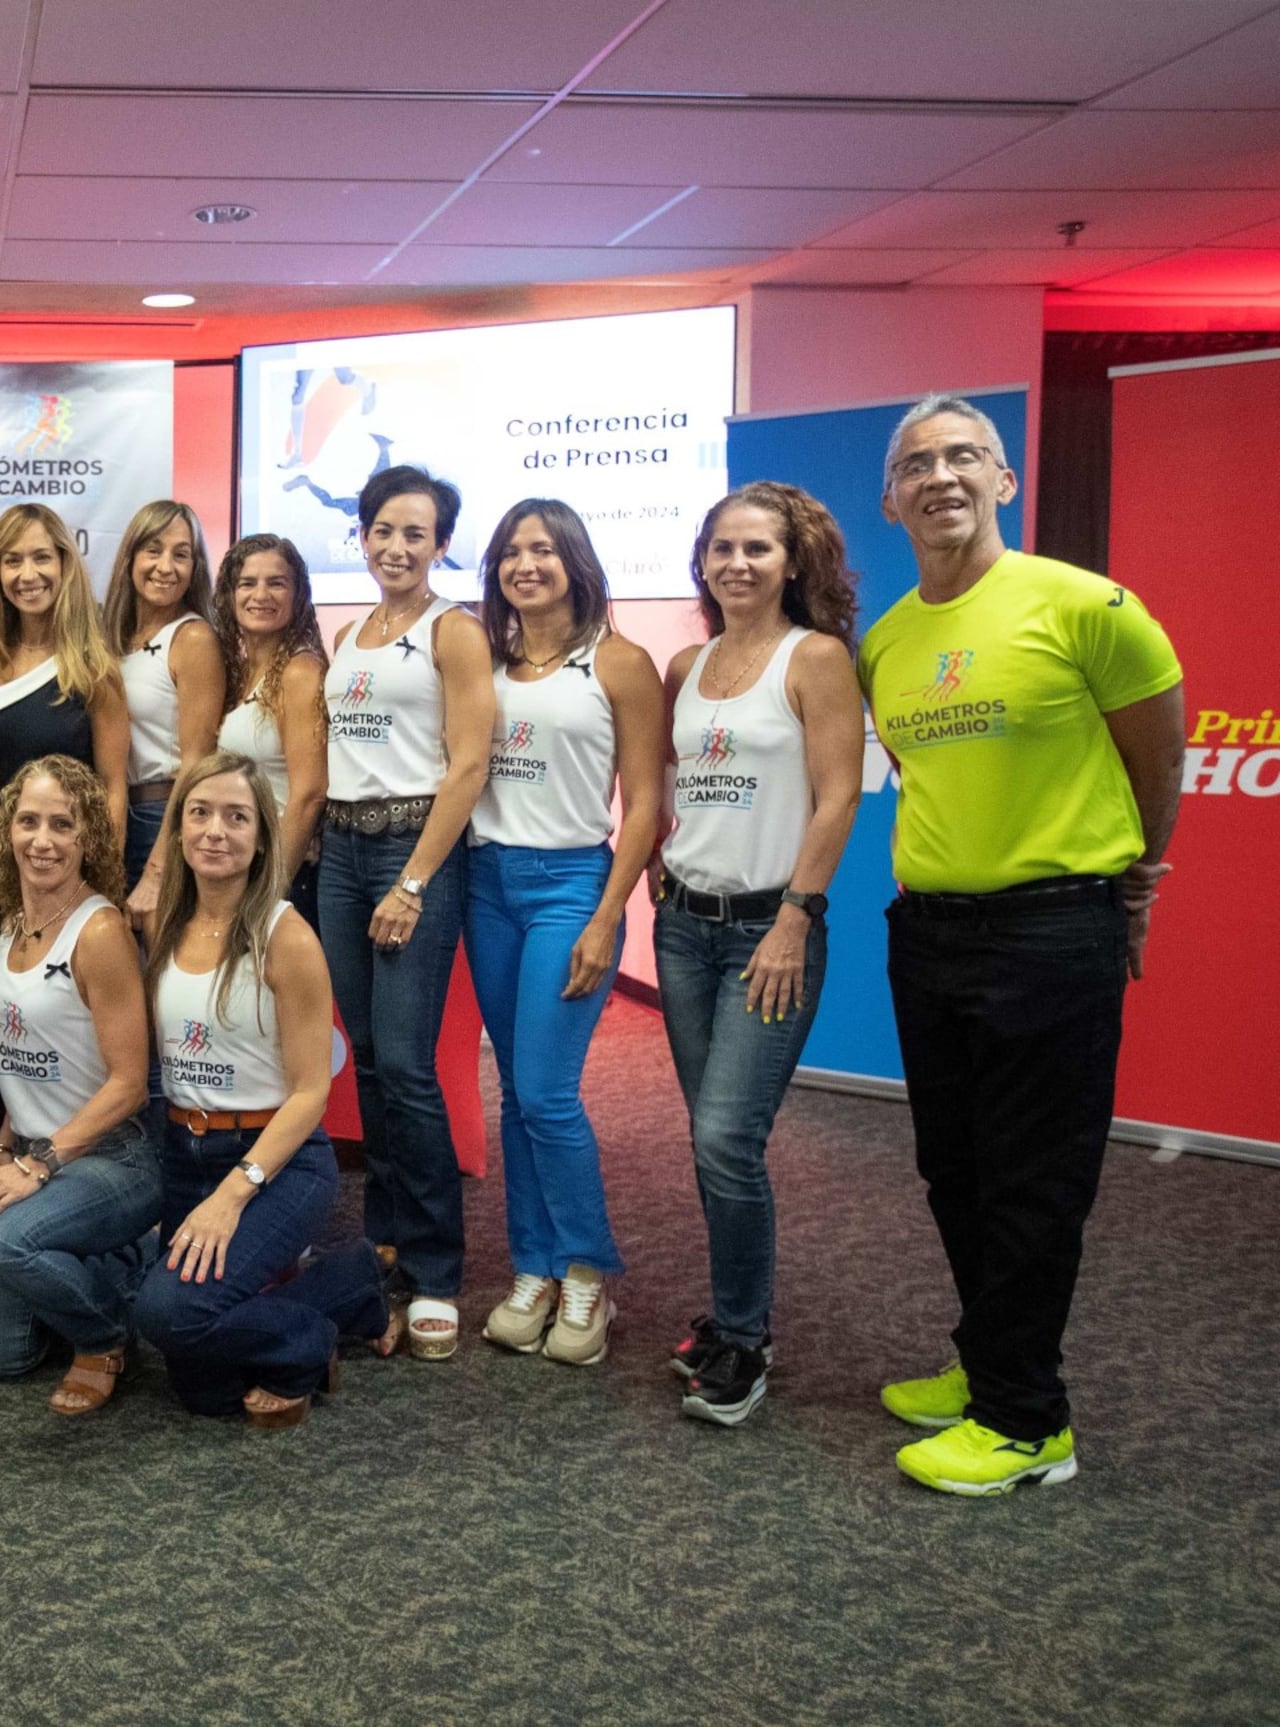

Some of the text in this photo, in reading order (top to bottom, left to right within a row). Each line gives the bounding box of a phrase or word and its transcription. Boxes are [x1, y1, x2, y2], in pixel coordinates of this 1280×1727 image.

[506, 408, 687, 437] Conferencia
[523, 447, 668, 469] de Prensa
[581, 511, 606, 522] yo
[332, 710, 393, 726] ÓMETROS
[886, 699, 1006, 732] KILÓMETROS
[914, 719, 989, 742] CAMBIO
[1187, 709, 1280, 744] Pri
[491, 753, 547, 771] ÓMETROS
[490, 766, 536, 780] CAMBIO
[676, 773, 757, 789] KILÓMETROS
[688, 790, 739, 803] CAMBIO
[1, 1058, 48, 1078] CAMBIO
[174, 1070, 223, 1087] CAMBIO
